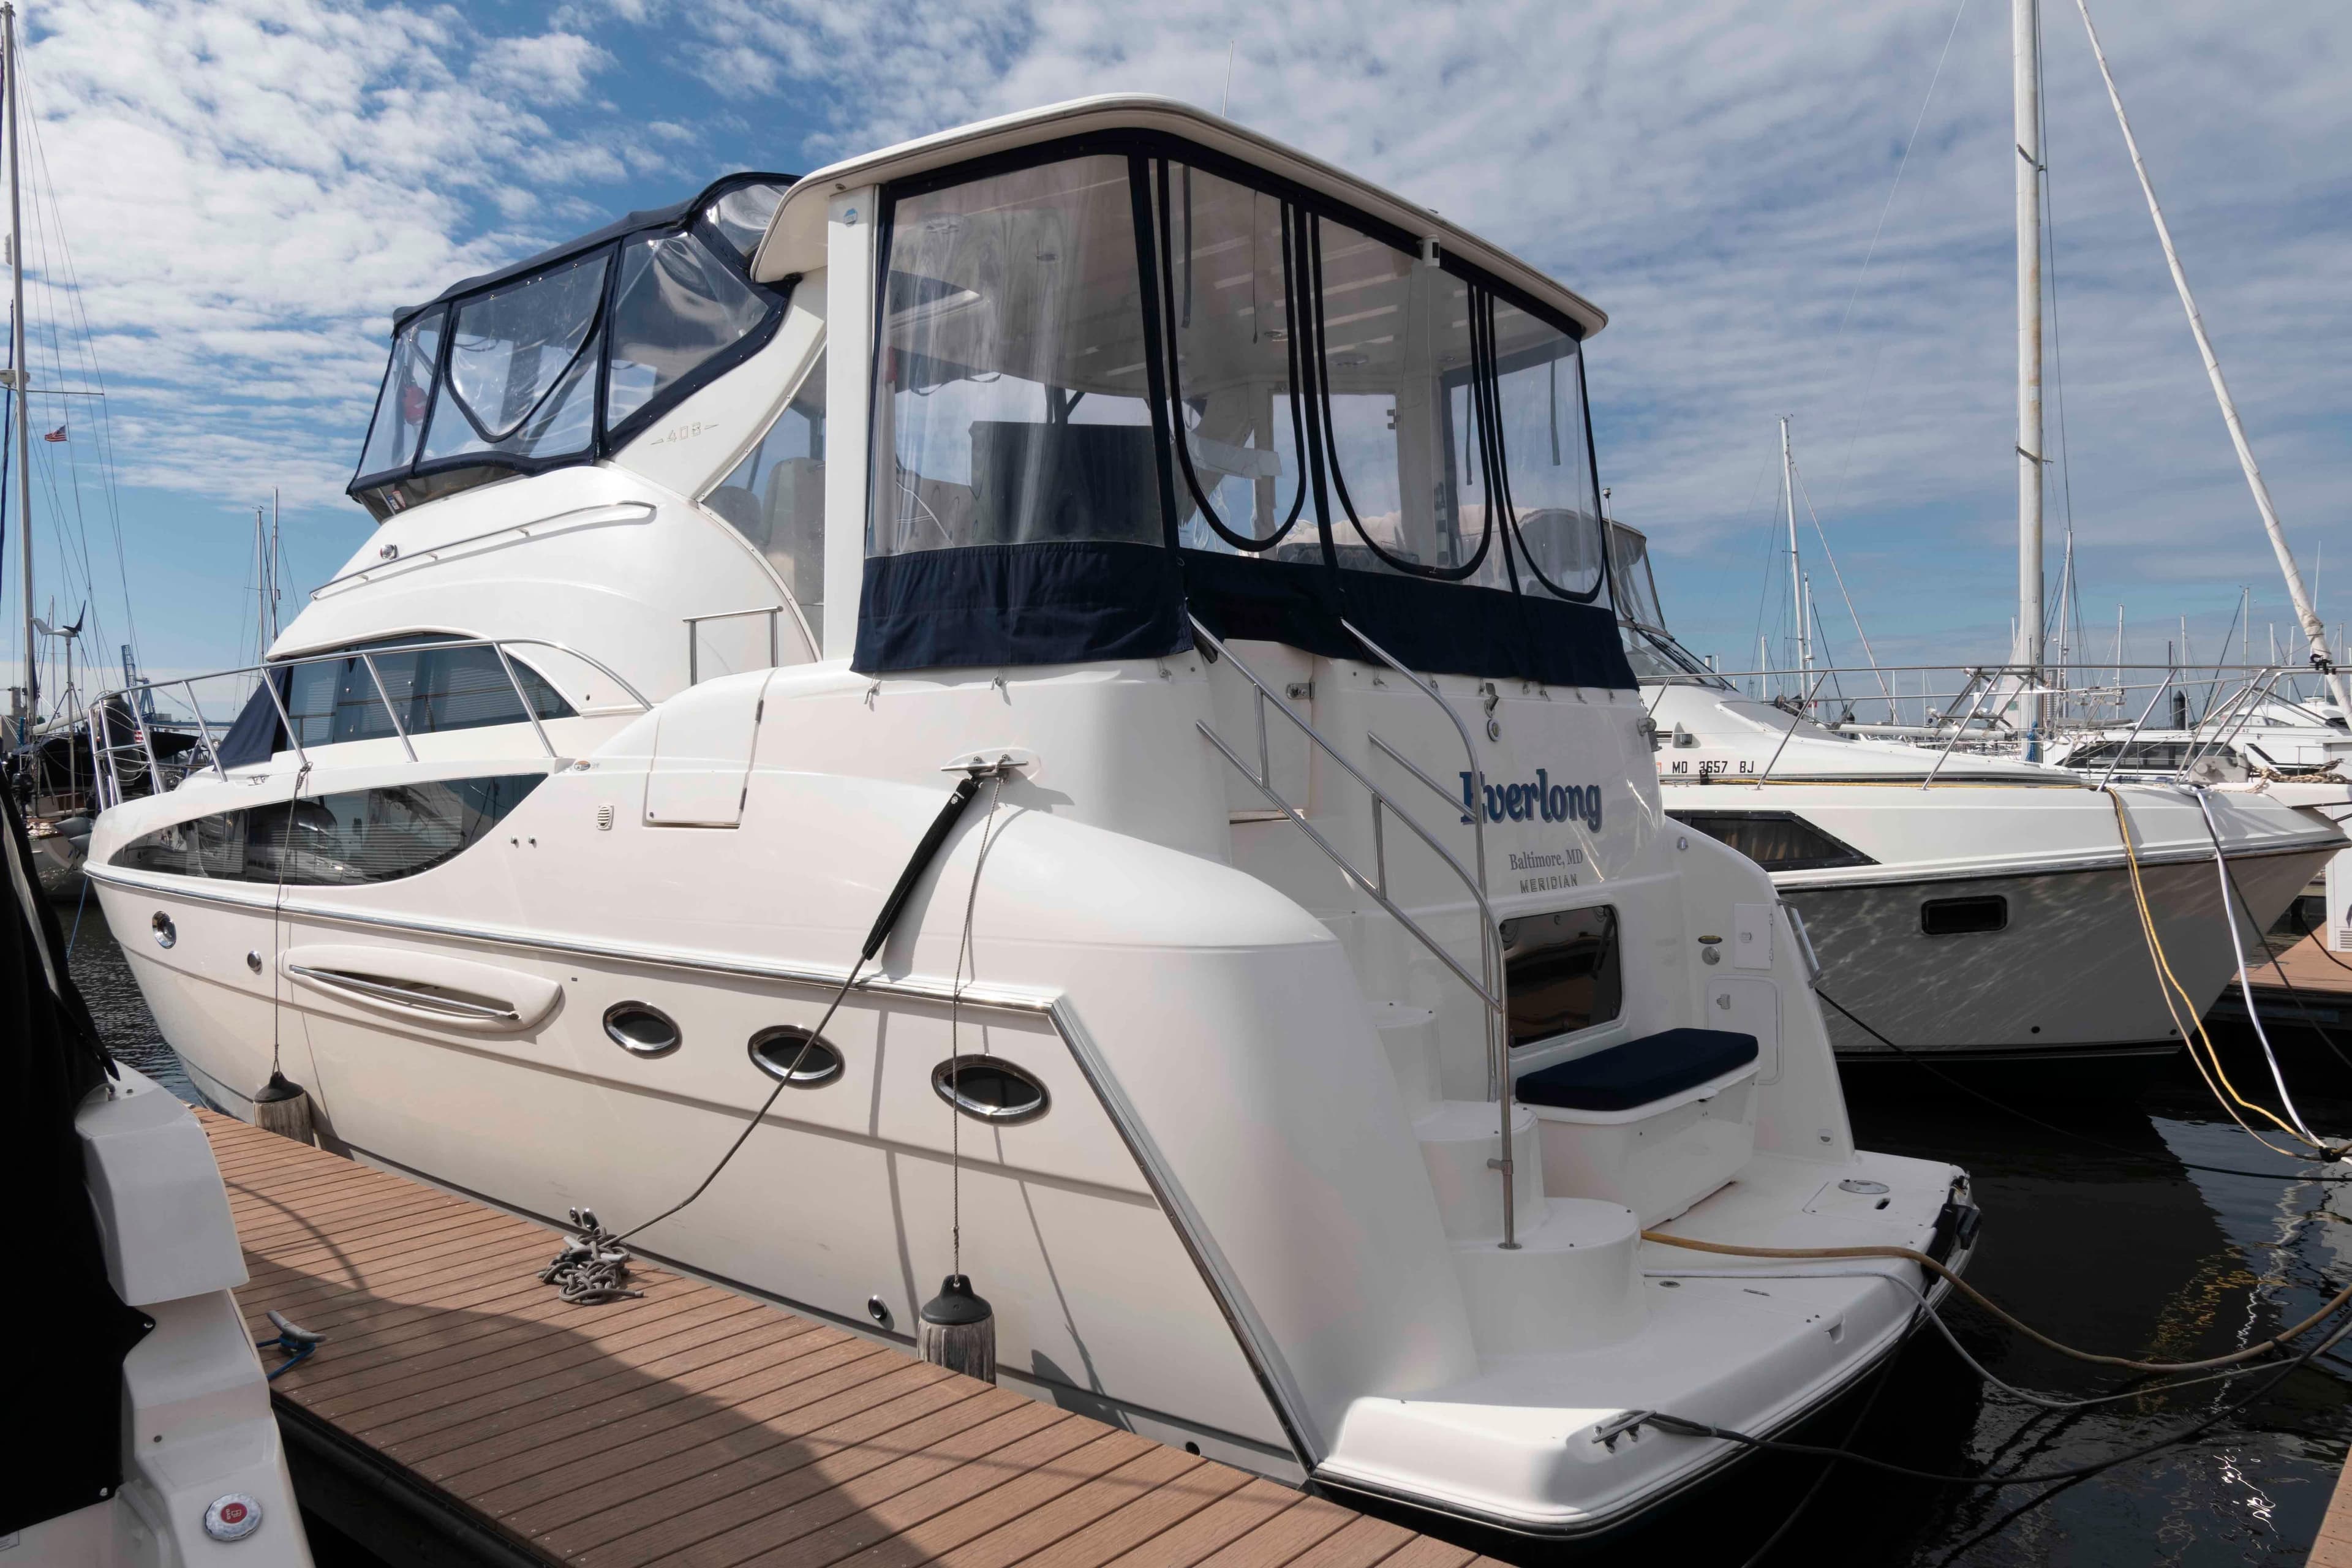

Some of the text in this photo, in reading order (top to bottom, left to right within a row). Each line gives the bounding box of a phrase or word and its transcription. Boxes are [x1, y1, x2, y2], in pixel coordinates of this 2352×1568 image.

[1698, 761, 1728, 774] 3657
[1740, 761, 1754, 774] BJ
[1509, 848, 1583, 871] Baltimore, MD
[1520, 873, 1578, 894] MERIDIAN
